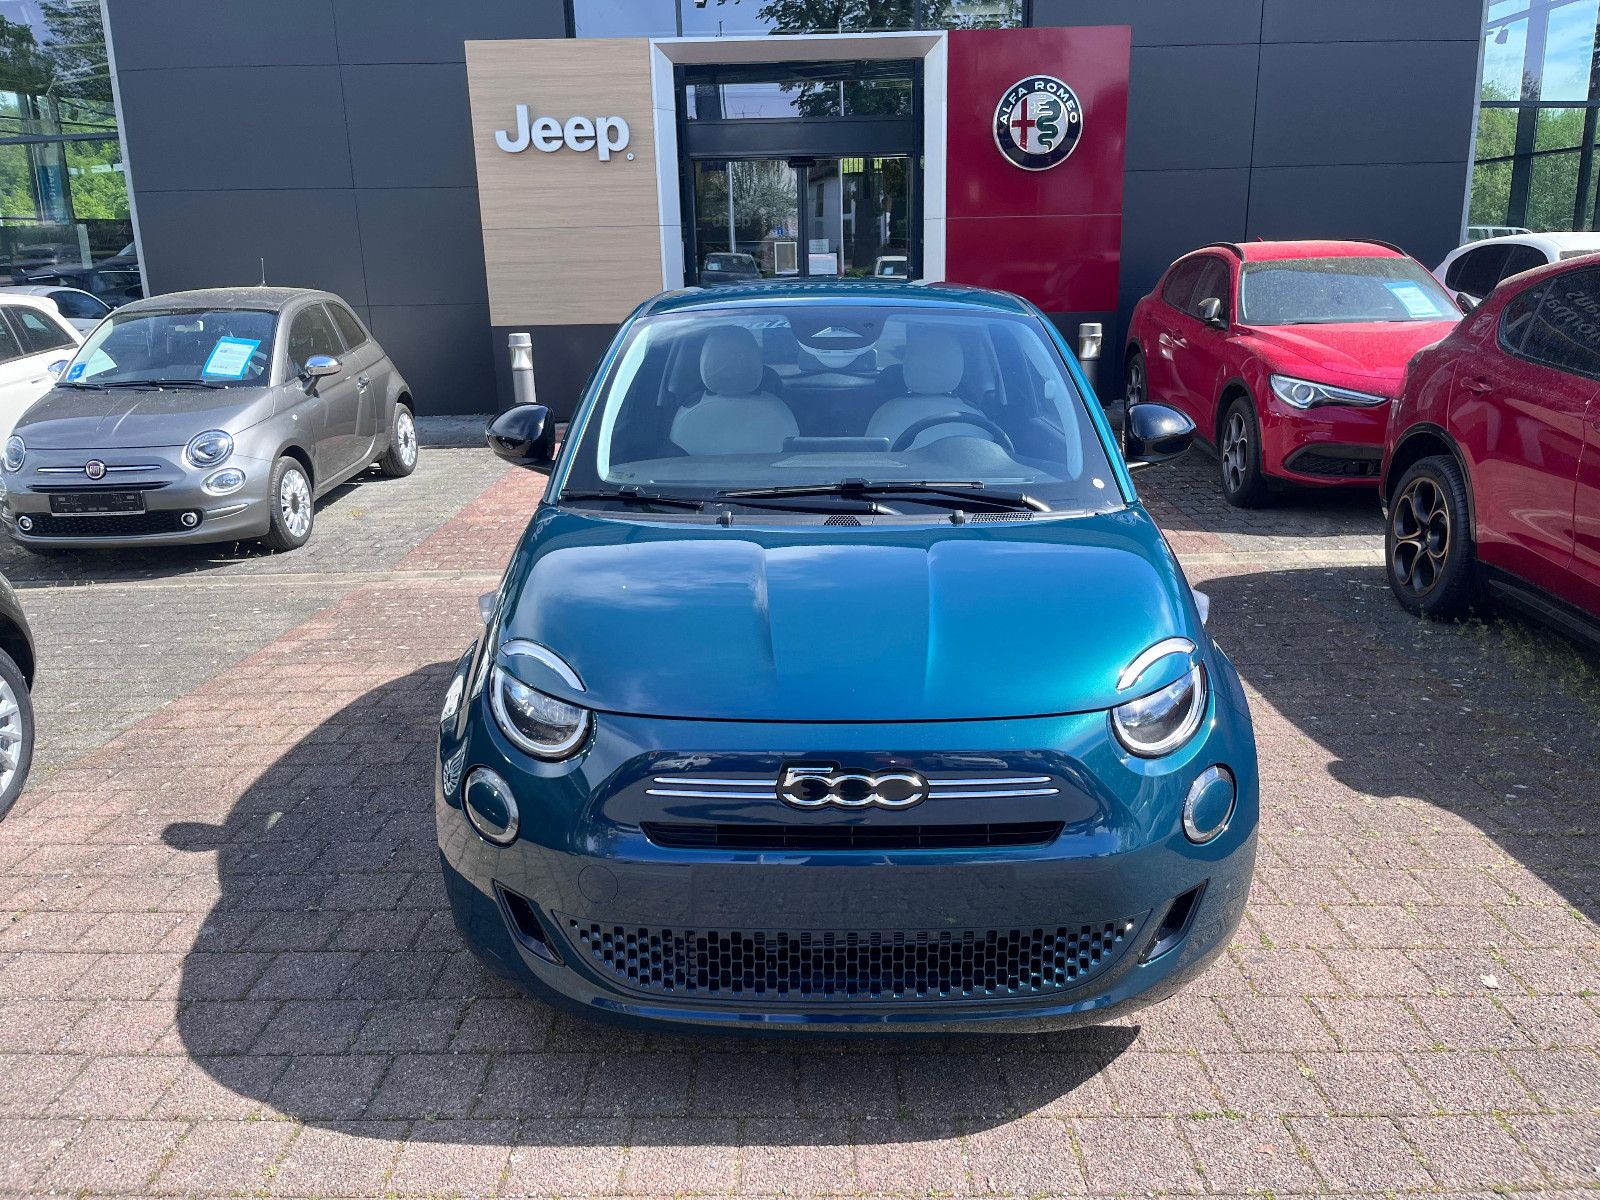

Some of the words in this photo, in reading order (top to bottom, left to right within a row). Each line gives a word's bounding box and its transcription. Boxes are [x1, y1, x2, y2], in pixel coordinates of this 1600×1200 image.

[1000, 87, 1028, 125] ALFA
[1034, 81, 1078, 123] ROMEO
[495, 104, 630, 162] Jeep
[783, 767, 923, 806] 500
